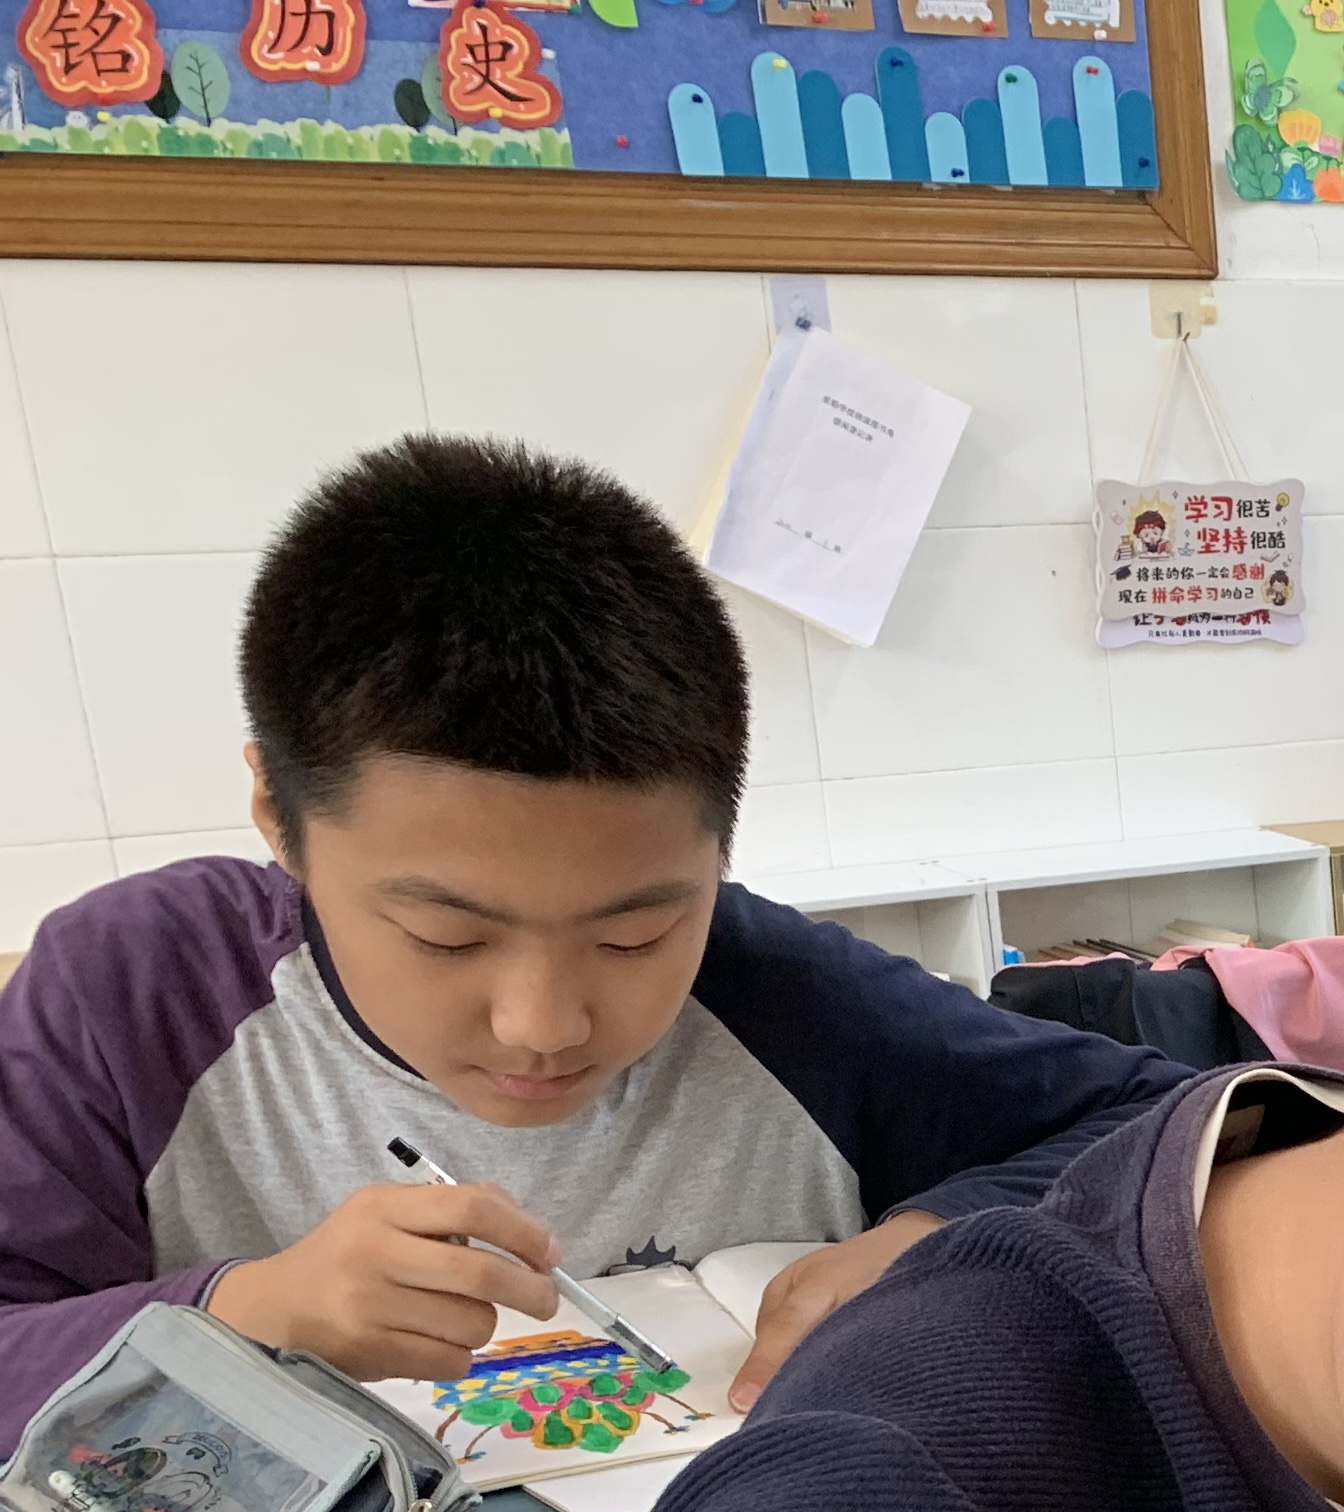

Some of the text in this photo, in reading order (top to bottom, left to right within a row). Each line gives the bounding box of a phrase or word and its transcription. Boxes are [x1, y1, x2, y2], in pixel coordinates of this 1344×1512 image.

[41, 2, 133, 77] 铭
[462, 20, 536, 102] 史
[1184, 496, 1271, 523] 学习很苦
[1197, 527, 1286, 555] 坚持很酷
[1136, 564, 1265, 582] 将来的你一定会感谢
[1118, 586, 1254, 605] 现在拼命学习的自己
